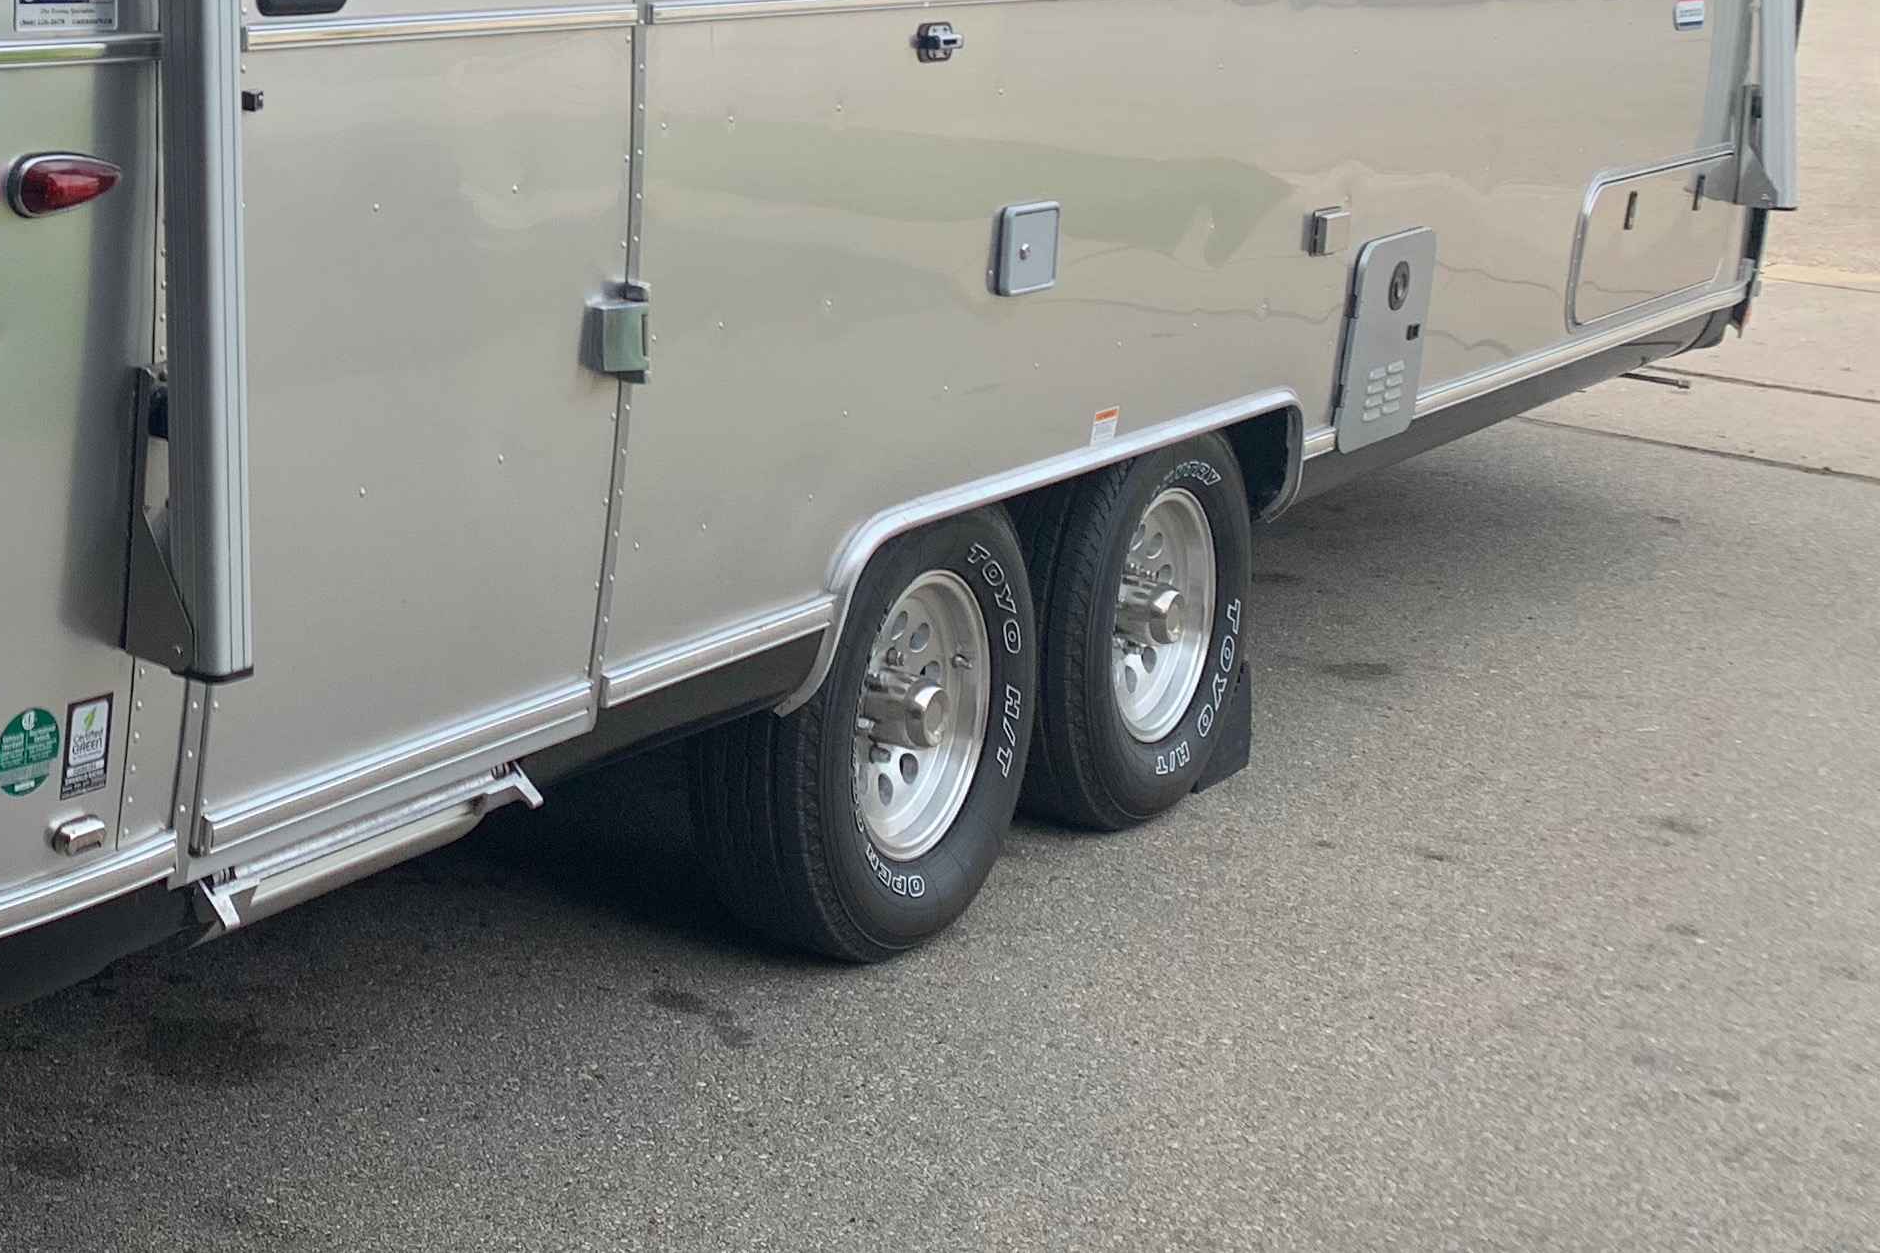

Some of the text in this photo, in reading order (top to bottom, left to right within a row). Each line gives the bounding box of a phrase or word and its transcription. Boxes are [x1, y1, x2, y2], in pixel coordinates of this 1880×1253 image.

[967, 543, 1021, 778] TOYO H/T
[1156, 598, 1241, 775] TOYO H/T
[866, 842, 925, 898] OPEN
